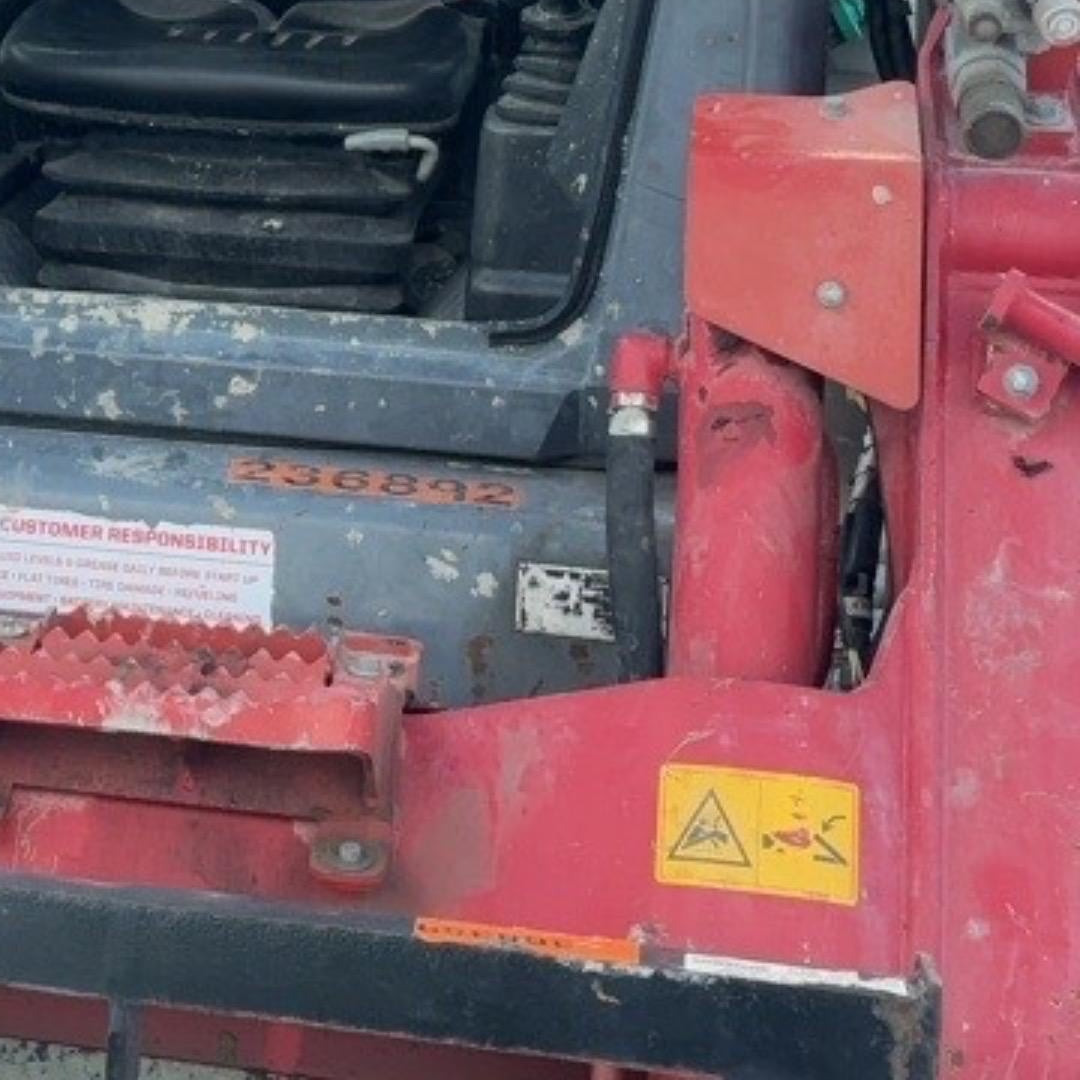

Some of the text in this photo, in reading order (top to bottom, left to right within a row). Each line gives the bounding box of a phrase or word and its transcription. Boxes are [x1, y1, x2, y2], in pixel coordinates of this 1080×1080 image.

[236, 461, 515, 507] 236892
[0, 518, 271, 556] CUSTOMER RESPONSIBILITY
[122, 562, 155, 575] DAILY
